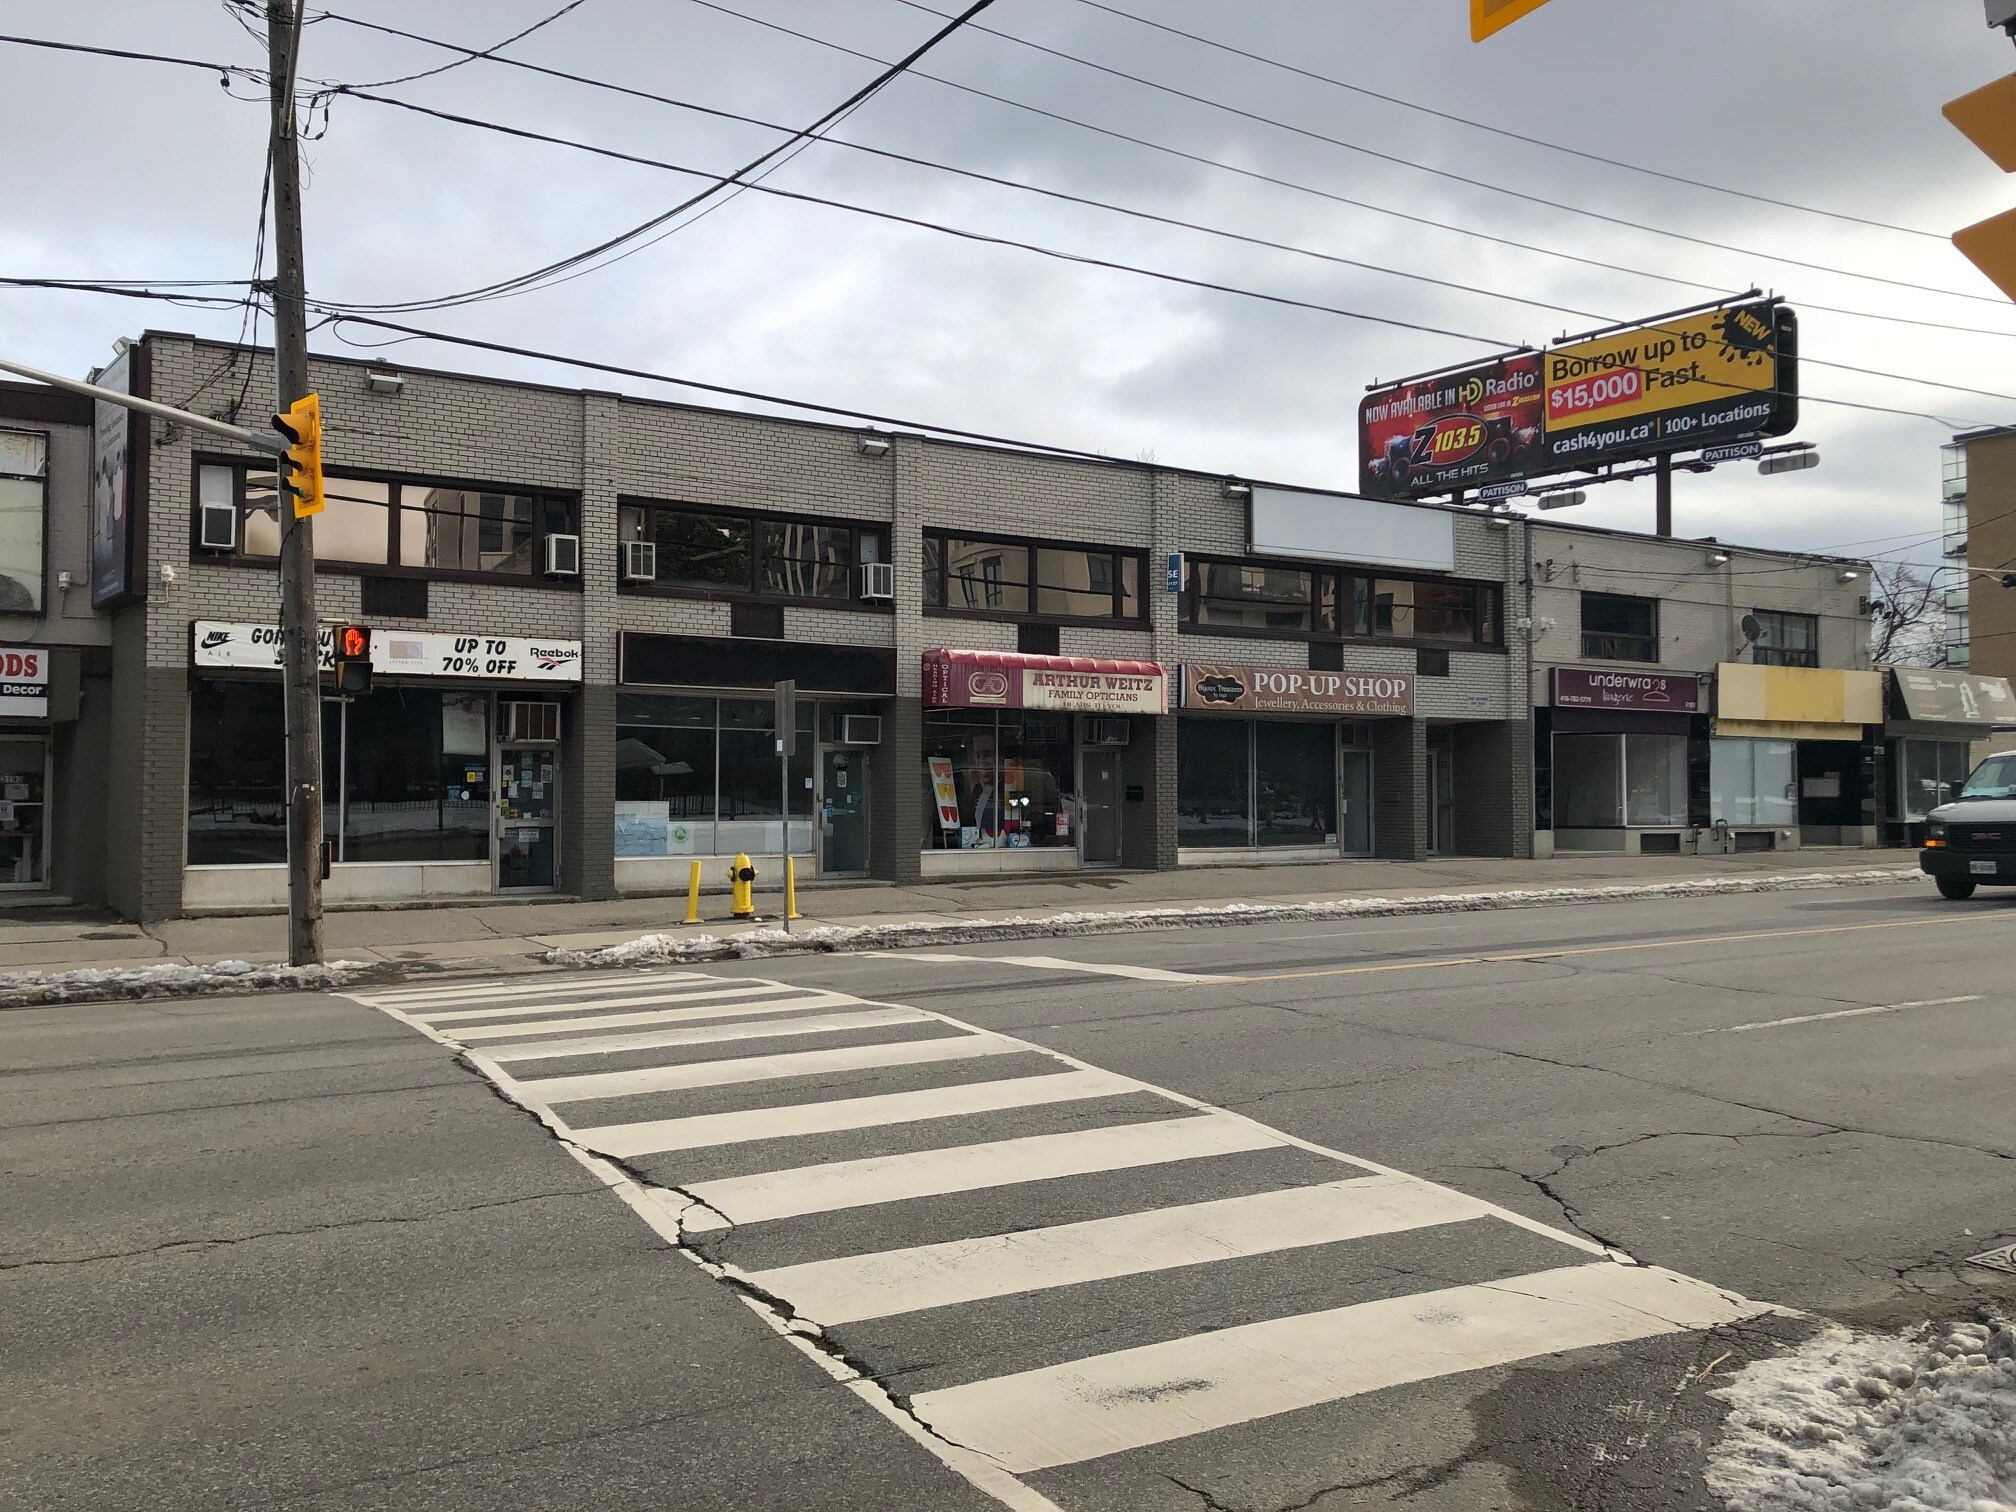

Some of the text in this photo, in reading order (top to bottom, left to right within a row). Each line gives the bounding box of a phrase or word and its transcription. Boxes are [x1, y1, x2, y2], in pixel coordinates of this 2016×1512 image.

[1733, 310, 1773, 341] NEW
[1552, 331, 1707, 382] Borrow up to
[1645, 361, 1706, 392] Fast.
[1551, 371, 1638, 409] $15,000
[1365, 404, 1389, 424] NOW
[1390, 392, 1442, 416] AVAILABLE
[1445, 388, 1456, 405] IN
[1665, 416, 1698, 435] 100+
[1701, 402, 1771, 428] Locations
[1705, 444, 1759, 461] PATTISON
[1410, 463, 1489, 486] ALL THE HITS
[1482, 482, 1525, 498] PATTISON
[206, 631, 231, 642] NIKE
[454, 638, 507, 655] UP TO
[530, 647, 579, 658] Reebok
[442, 657, 517, 674] 70% OFF
[3, 684, 42, 695] Decor
[1032, 674, 1154, 692] ARTHUR WEITZ
[1253, 672, 1406, 699] POP-UP SHOP
[1589, 673, 1667, 690] underwras
[1048, 689, 1139, 702] FAMILY OPTICIANS
[1254, 696, 1406, 715] Jewellery, Accessories & Clothing
